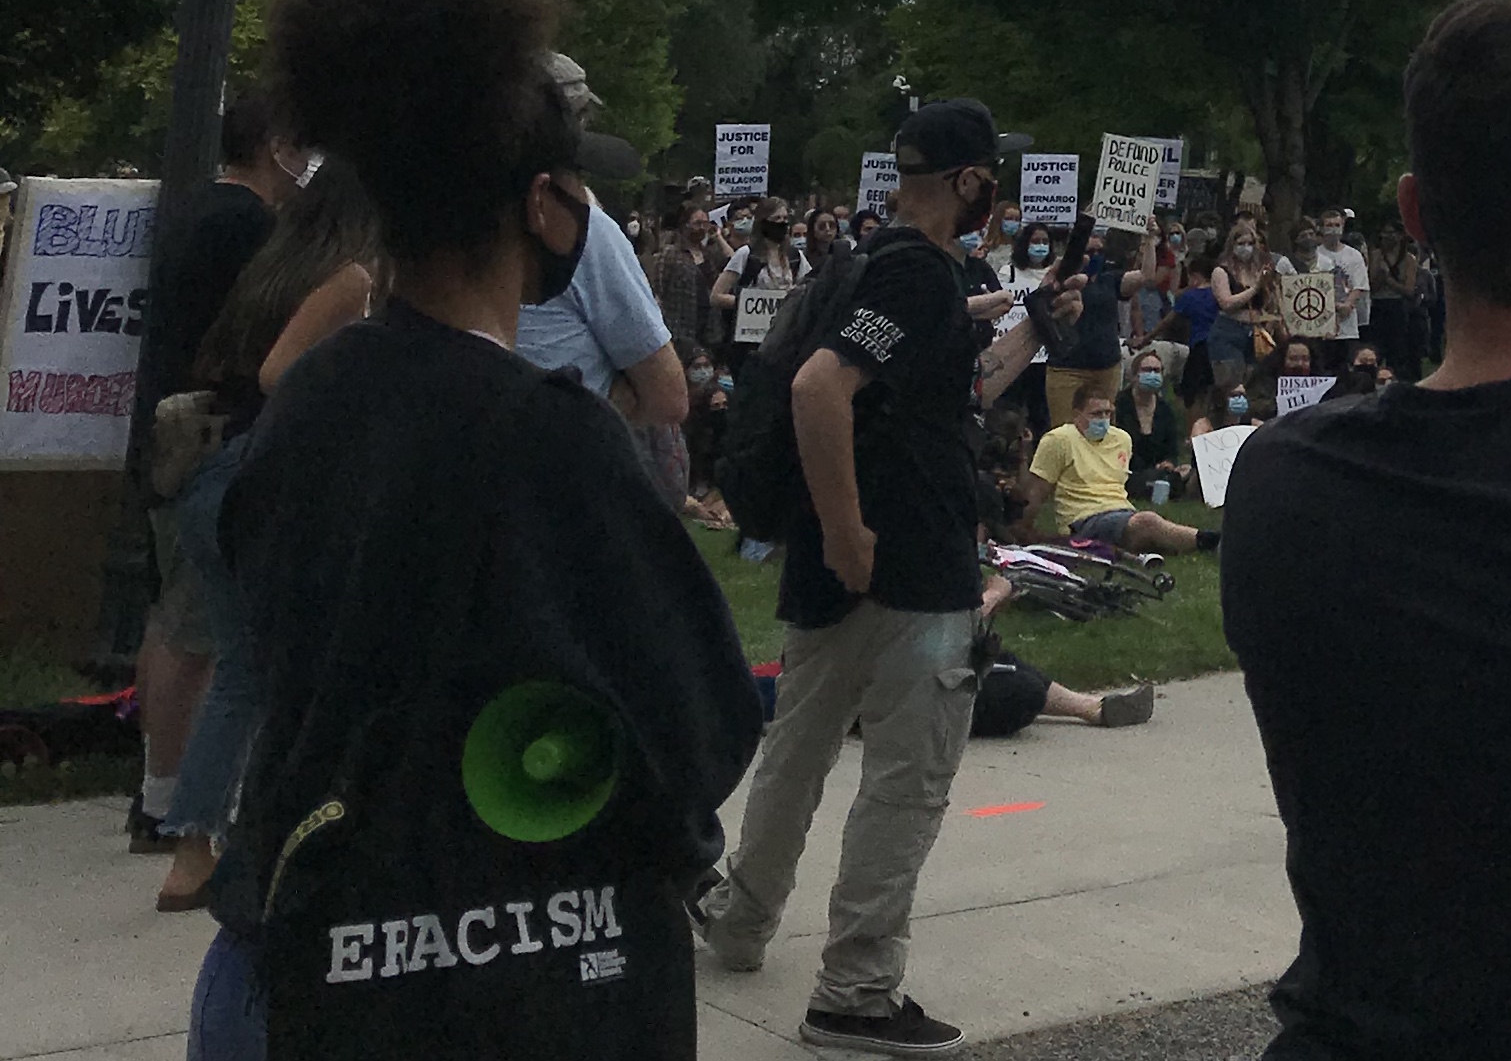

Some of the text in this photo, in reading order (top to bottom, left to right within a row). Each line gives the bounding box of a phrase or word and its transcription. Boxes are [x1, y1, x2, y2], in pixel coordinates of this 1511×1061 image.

[718, 131, 769, 142] JUSTICE
[730, 145, 755, 155] FOR
[1109, 140, 1159, 164] DEFUND
[718, 166, 767, 174] BERNARDO
[1024, 161, 1077, 172] JUSTICE
[1108, 157, 1149, 177] POLICE
[719, 176, 763, 184] PALACIOS
[876, 172, 898, 183] FOR
[1035, 174, 1061, 185] FOR
[1023, 194, 1076, 203] BERNARDO
[1024, 205, 1072, 213] PALACIOS
[853, 308, 905, 344] NO MORE
[851, 318, 892, 351] STOLEN
[1203, 429, 1241, 452] NO
